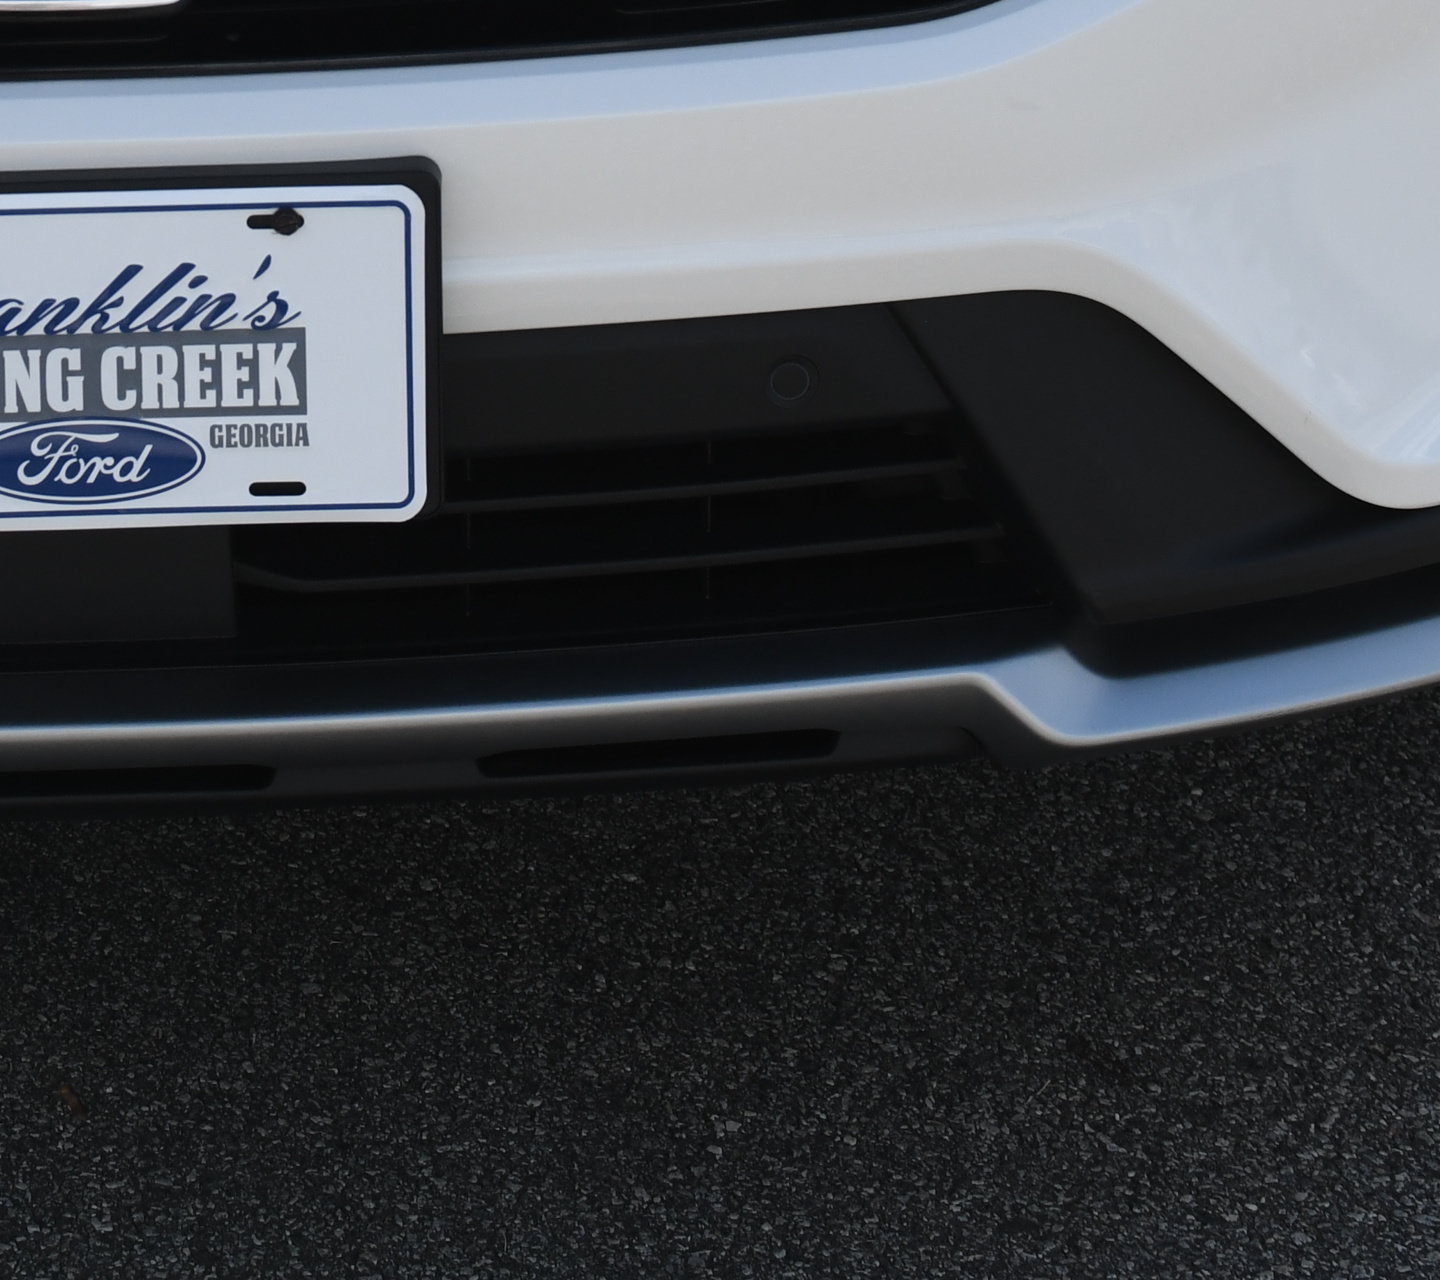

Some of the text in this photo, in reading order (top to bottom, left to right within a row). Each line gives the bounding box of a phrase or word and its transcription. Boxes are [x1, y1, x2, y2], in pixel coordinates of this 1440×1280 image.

[100, 342, 301, 413] CREEK
[17, 430, 152, 486] Ford
[209, 423, 310, 450] GEORGIA
